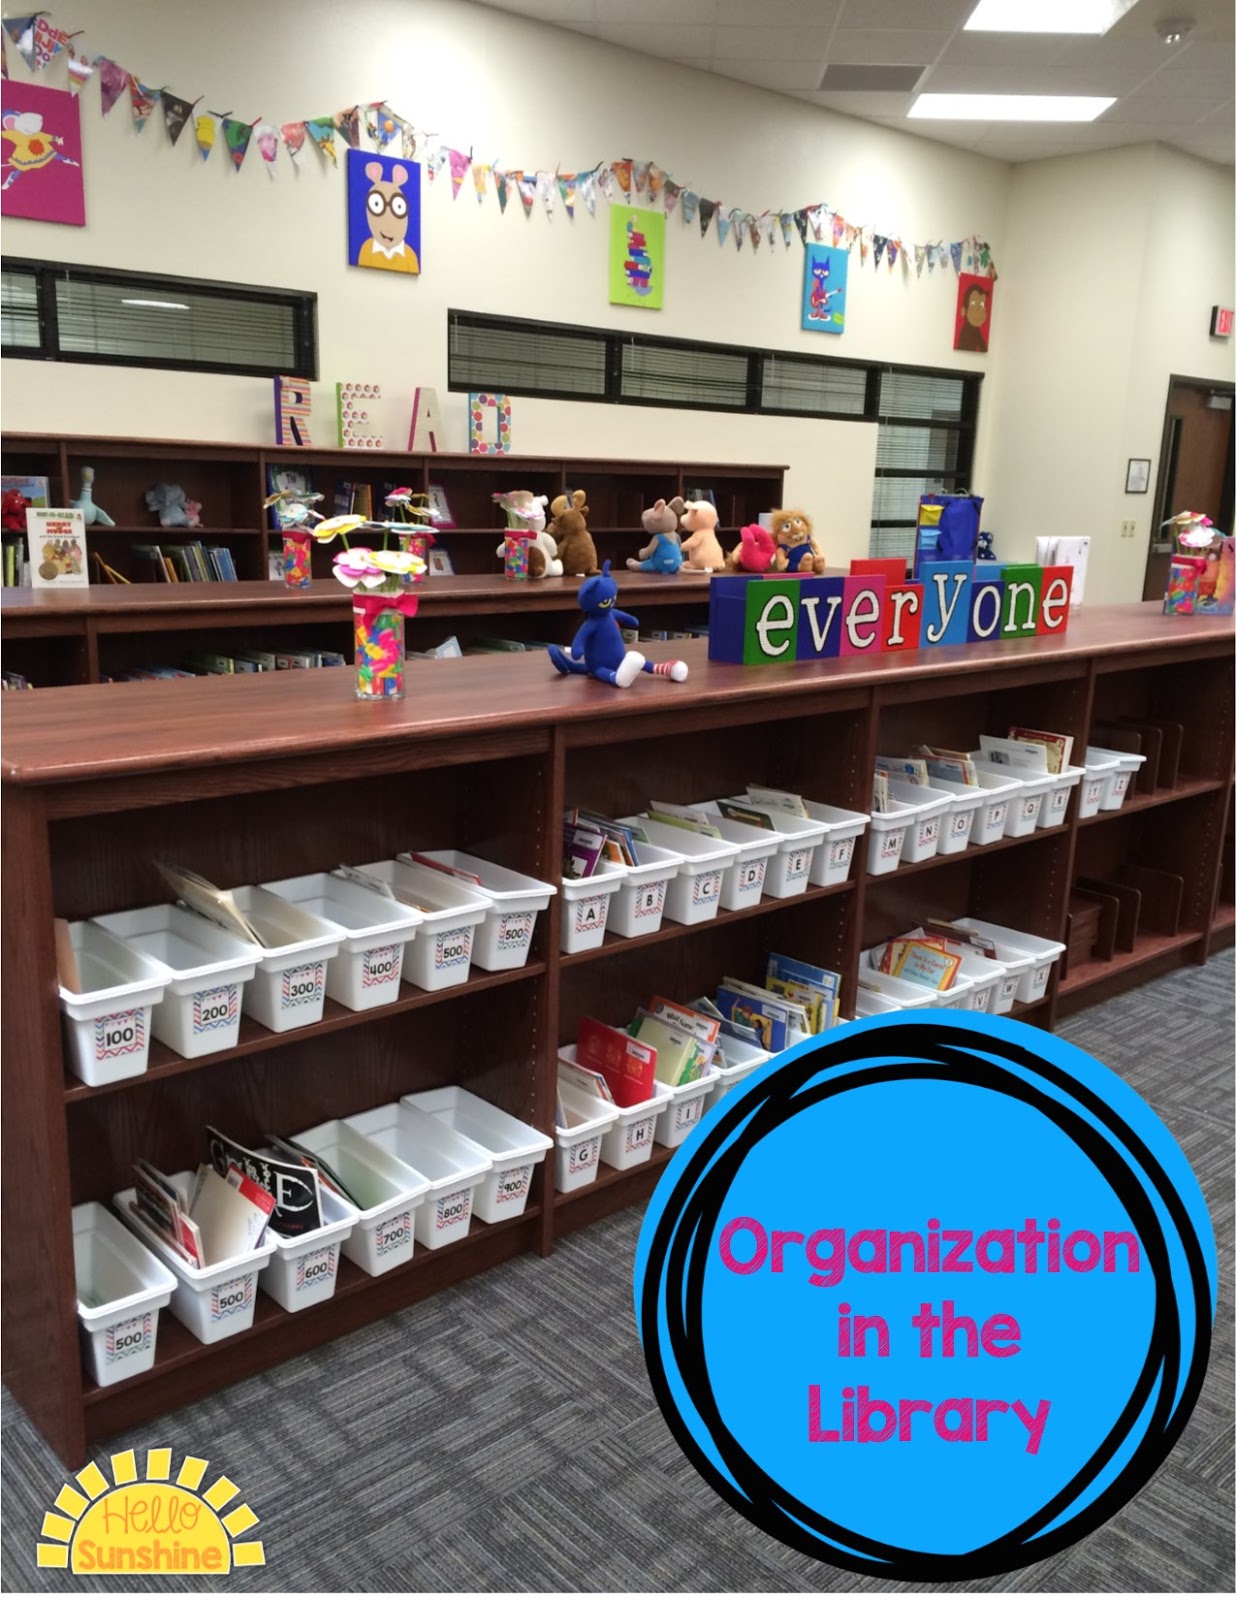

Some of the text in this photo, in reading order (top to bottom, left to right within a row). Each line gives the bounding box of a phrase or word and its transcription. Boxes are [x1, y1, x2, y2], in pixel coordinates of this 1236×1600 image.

[274, 374, 512, 454] READ
[756, 572, 1068, 657] everyone
[957, 819, 963, 829] O
[926, 826, 932, 836] N
[888, 839, 897, 849] M
[838, 849, 845, 860] F
[795, 858, 802, 870] E
[748, 870, 756, 882] D
[702, 882, 711, 895] C
[646, 895, 653, 907] B
[586, 908, 595, 921] A
[505, 928, 523, 940] 500
[443, 945, 463, 958] 500
[369, 961, 392, 975] 400
[291, 982, 314, 996] 300
[202, 1004, 228, 1022] 200
[106, 1027, 134, 1046] 100
[636, 1128, 644, 1142] H
[579, 1149, 588, 1161] G
[504, 1181, 522, 1193] 900
[444, 1204, 463, 1219] 800
[384, 1228, 404, 1244] 700
[305, 1262, 328, 1279] 600
[220, 1291, 244, 1309] 500
[115, 1332, 142, 1350] 500
